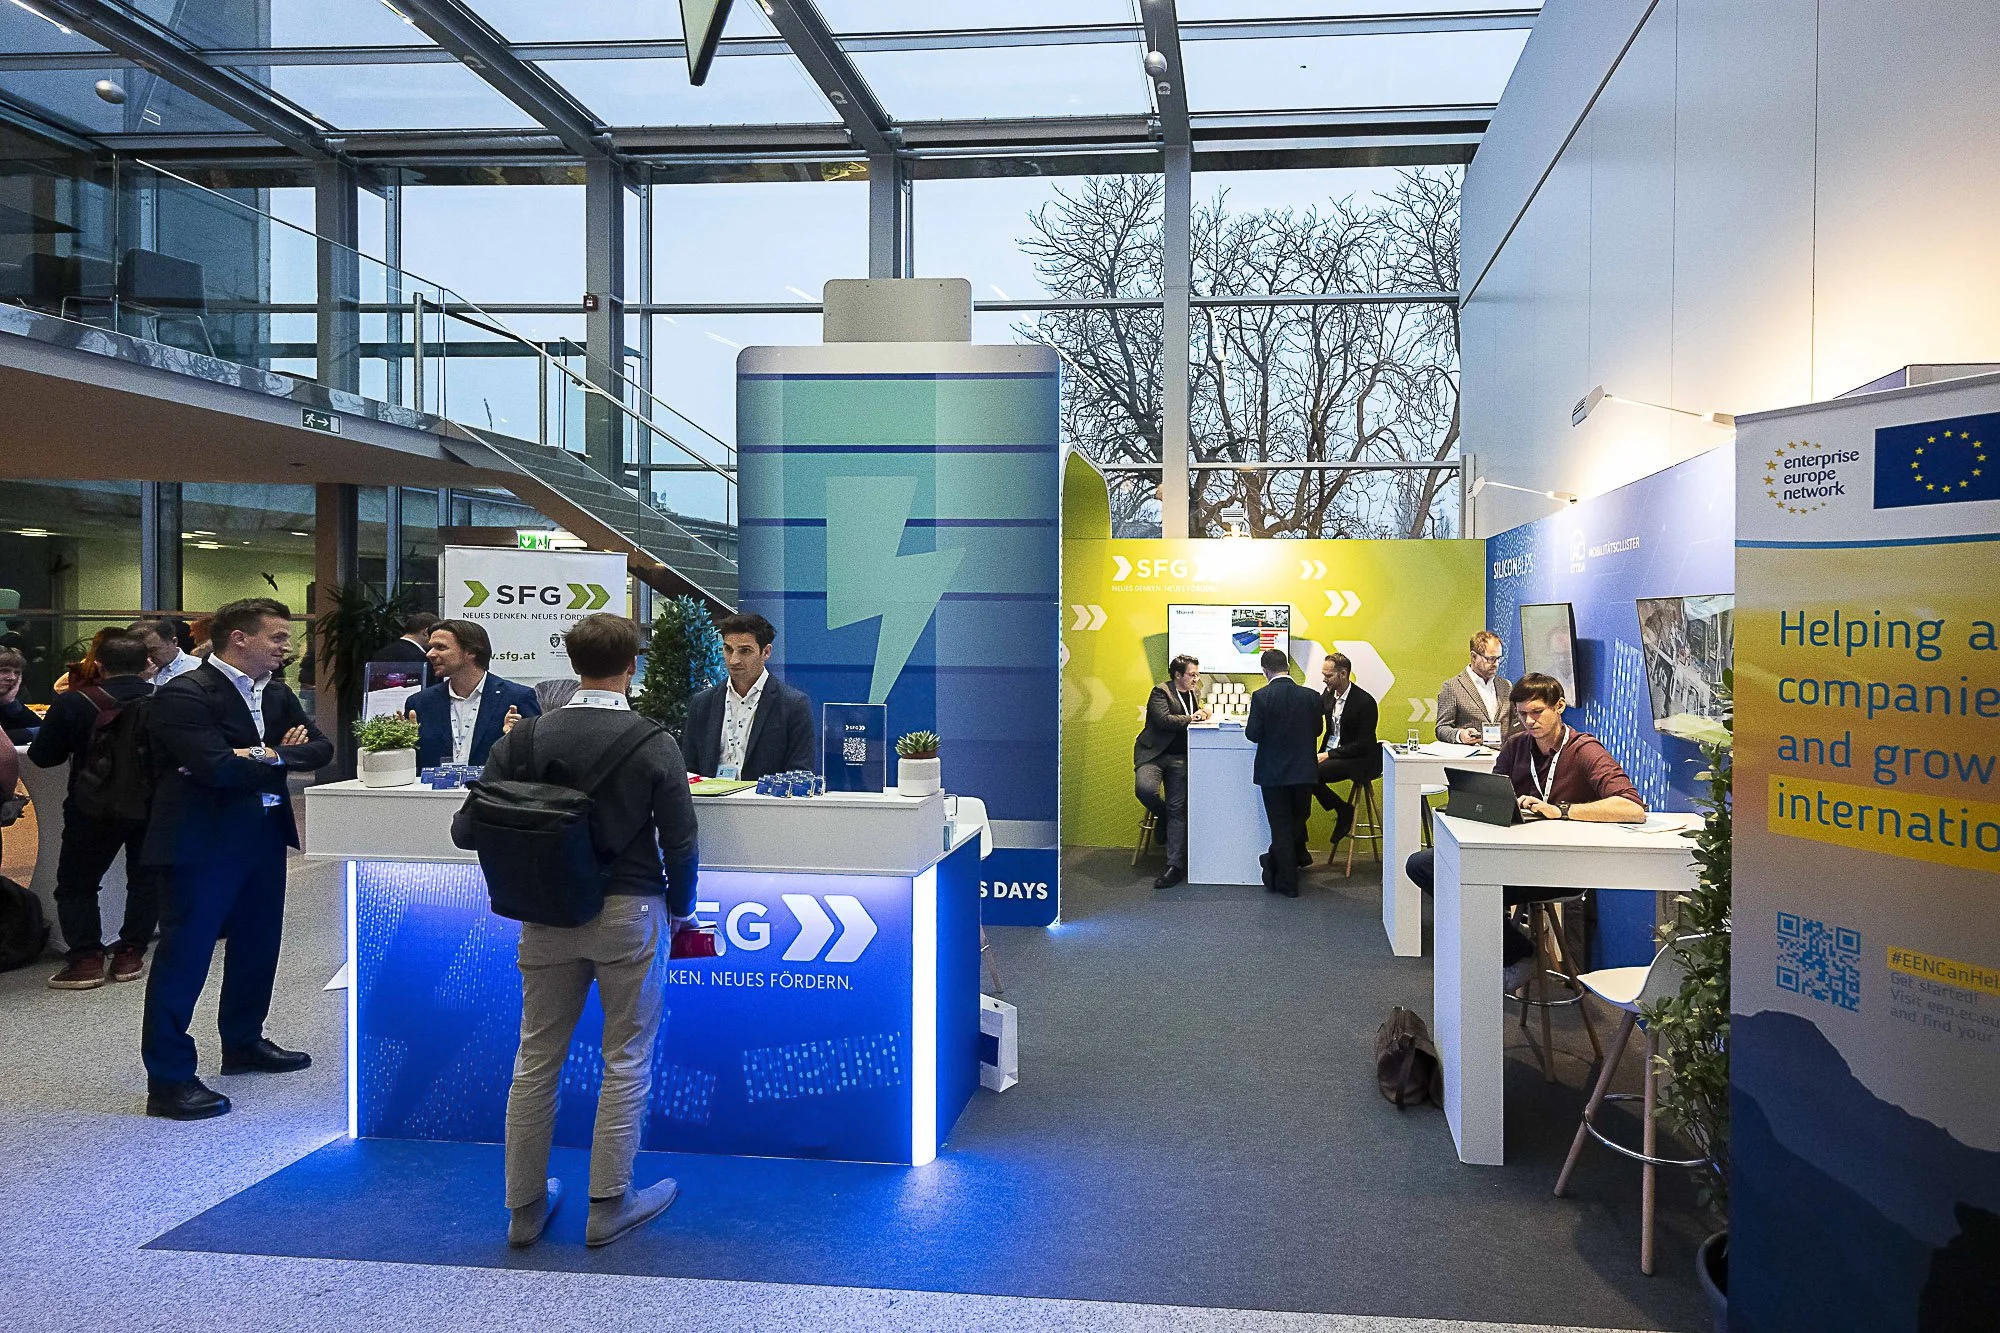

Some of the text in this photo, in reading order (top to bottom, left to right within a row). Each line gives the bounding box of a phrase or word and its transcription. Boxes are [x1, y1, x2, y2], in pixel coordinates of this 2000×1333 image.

[1784, 450, 1860, 469] enterprise
[1784, 469, 1836, 485] europe
[1784, 481, 1845, 500] network
[1136, 558, 1189, 579] SFG
[496, 584, 561, 606] SFG
[462, 612, 585, 621] NEUES DENKEN. NEUES FÖRD
[1780, 609, 1945, 662] Helping
[1778, 675, 2000, 720] companie
[1778, 730, 1997, 785] and grow
[1778, 782, 2000, 852] internatio
[993, 881, 1049, 900] DAYS
[711, 971, 764, 987] NEUES
[770, 970, 853, 990] FÖRDERN.
[1890, 971, 1914, 989] Get
[1891, 951, 1999, 989] #EENCanHel
[1890, 987, 1922, 1008] Visit
[1890, 1007, 1994, 1043] and find your
